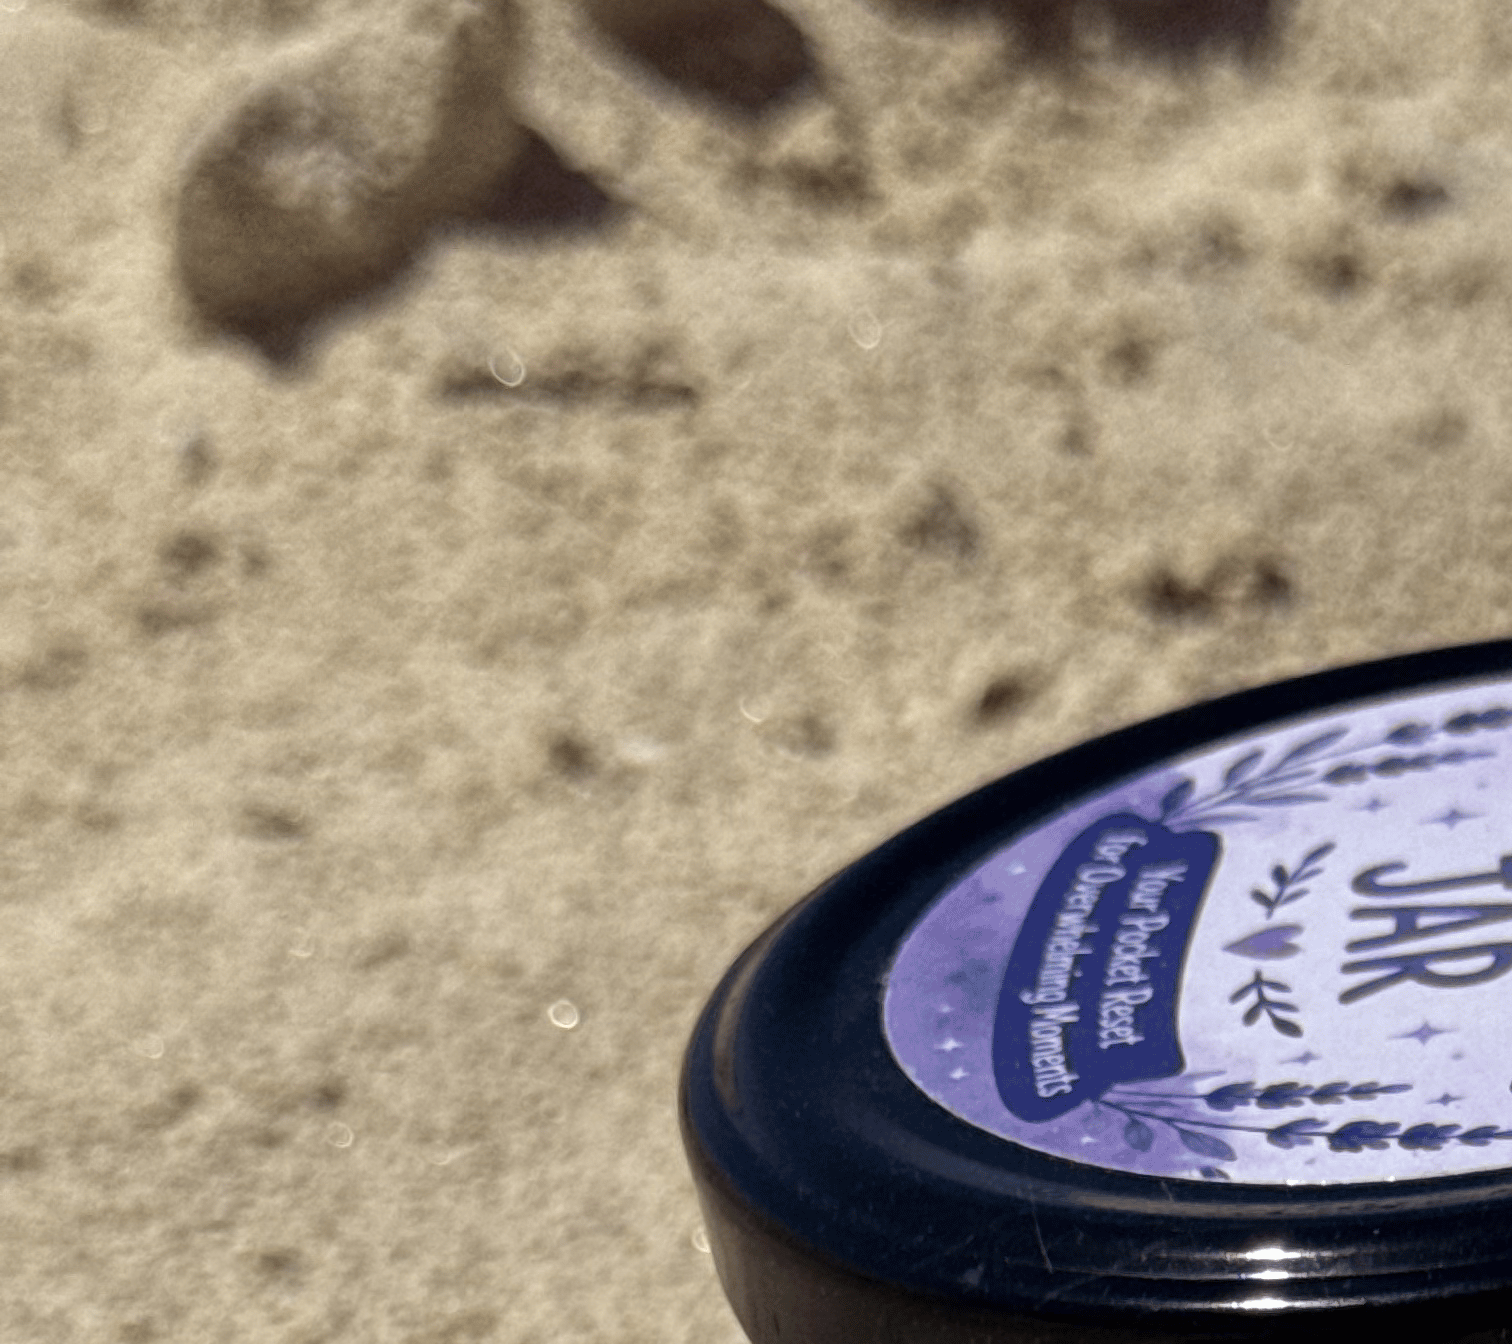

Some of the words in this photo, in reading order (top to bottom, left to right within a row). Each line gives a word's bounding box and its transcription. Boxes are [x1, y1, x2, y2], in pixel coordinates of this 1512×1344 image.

[1128, 859, 1189, 913] Your
[1018, 864, 1127, 1005] Overwhelming
[1103, 912, 1171, 986] Pocket
[1029, 1003, 1081, 1098] Moments
[1098, 986, 1154, 1049] Reset
